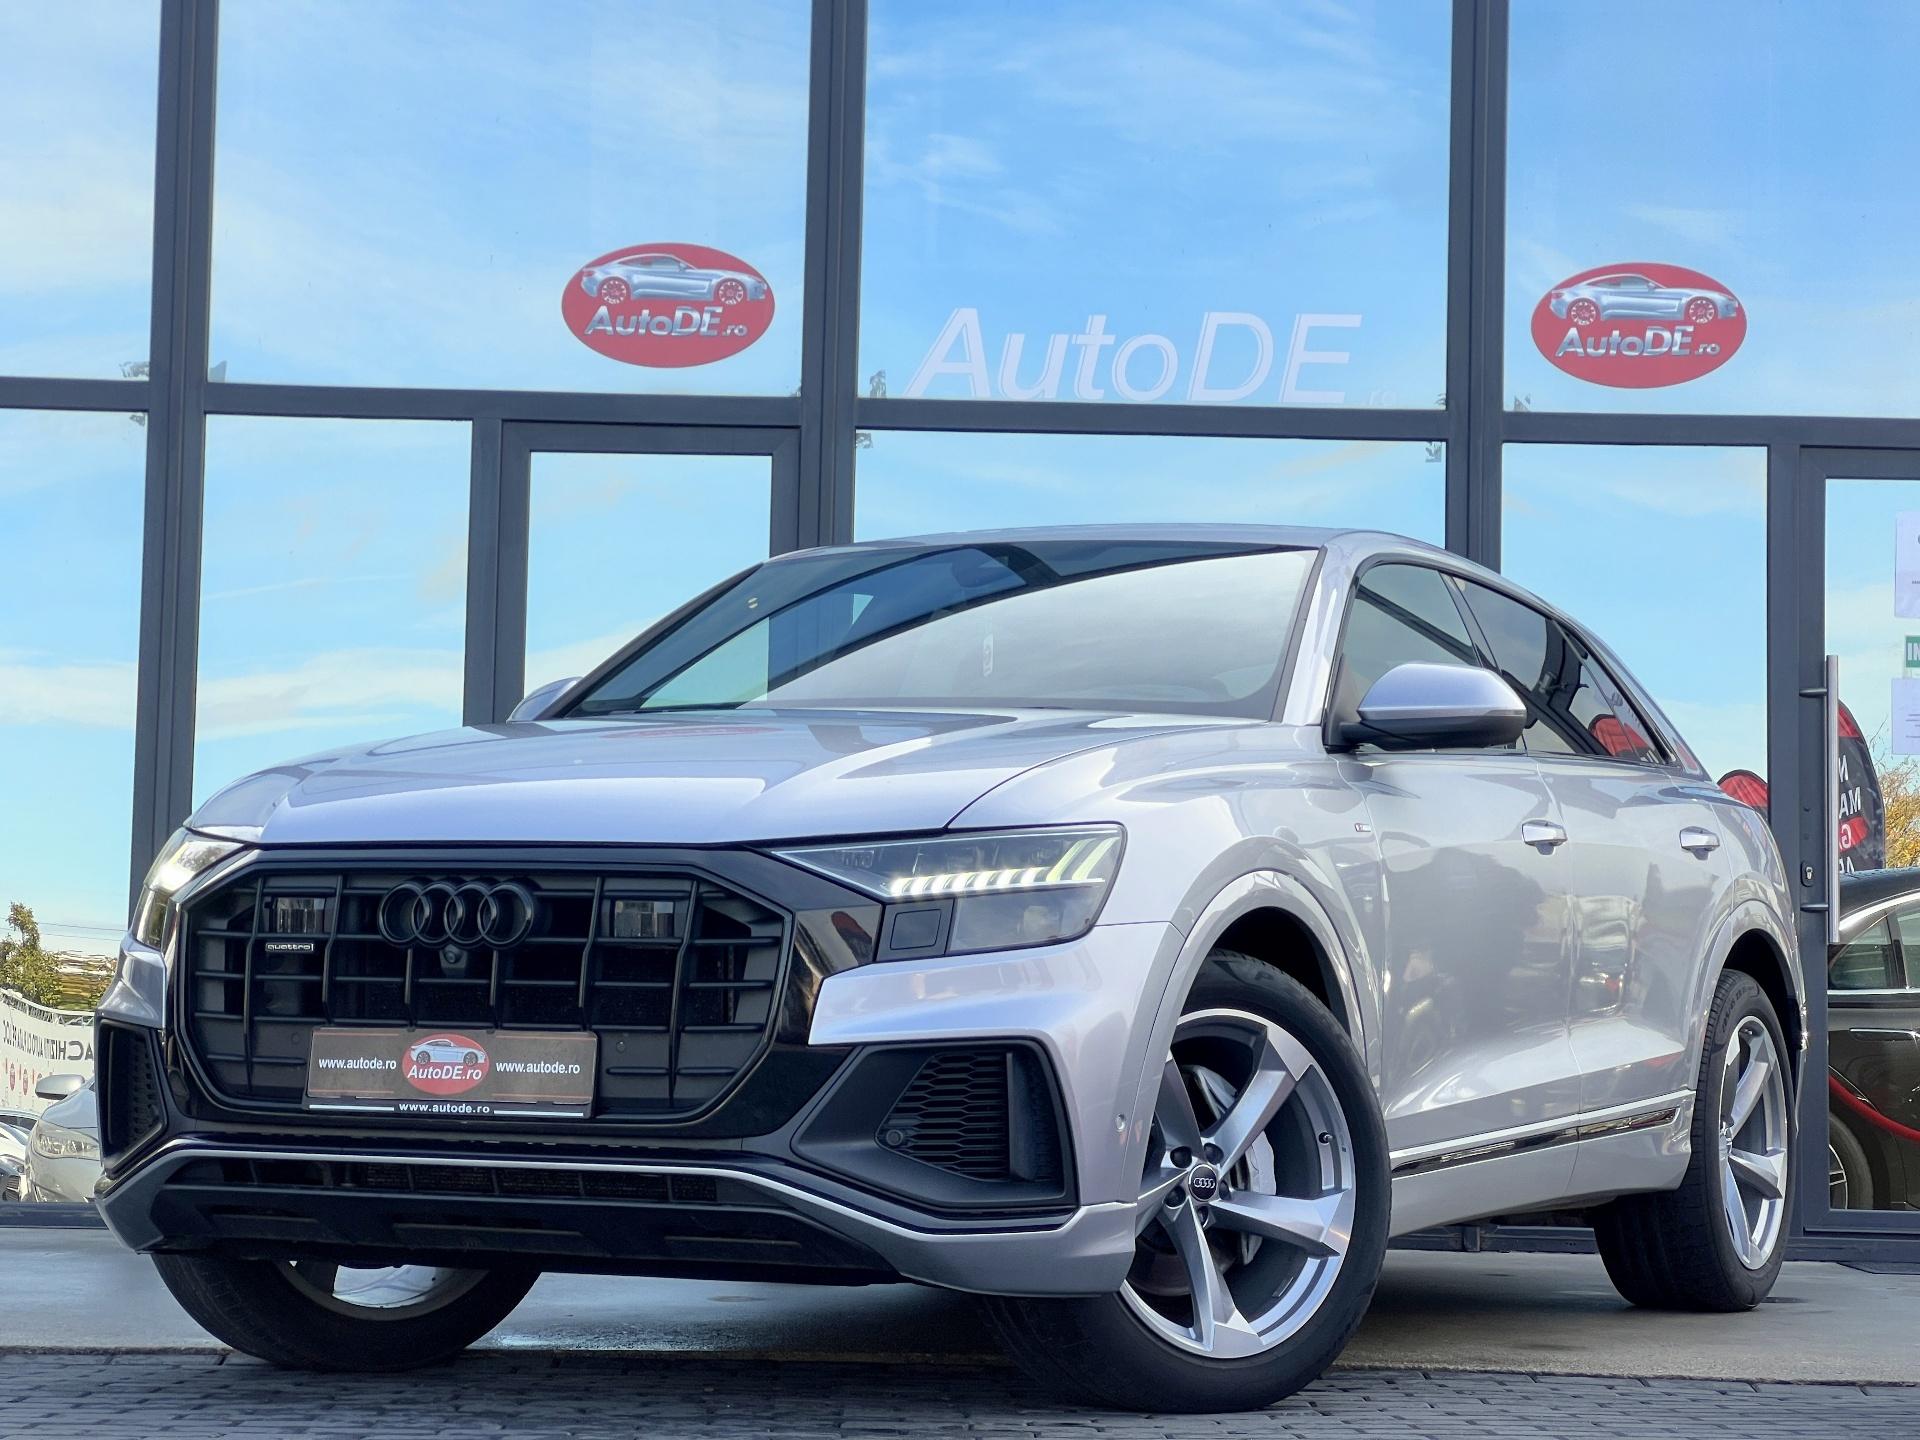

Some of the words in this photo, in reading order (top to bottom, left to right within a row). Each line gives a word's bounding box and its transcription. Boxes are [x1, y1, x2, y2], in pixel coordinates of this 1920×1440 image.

[266, 943, 312, 952] quattro
[318, 1056, 397, 1070] www.autode.ro
[495, 1060, 581, 1075] www.autode.ro
[407, 1064, 482, 1081] AutoDE.ro
[399, 1102, 490, 1114] www.autode.ro
